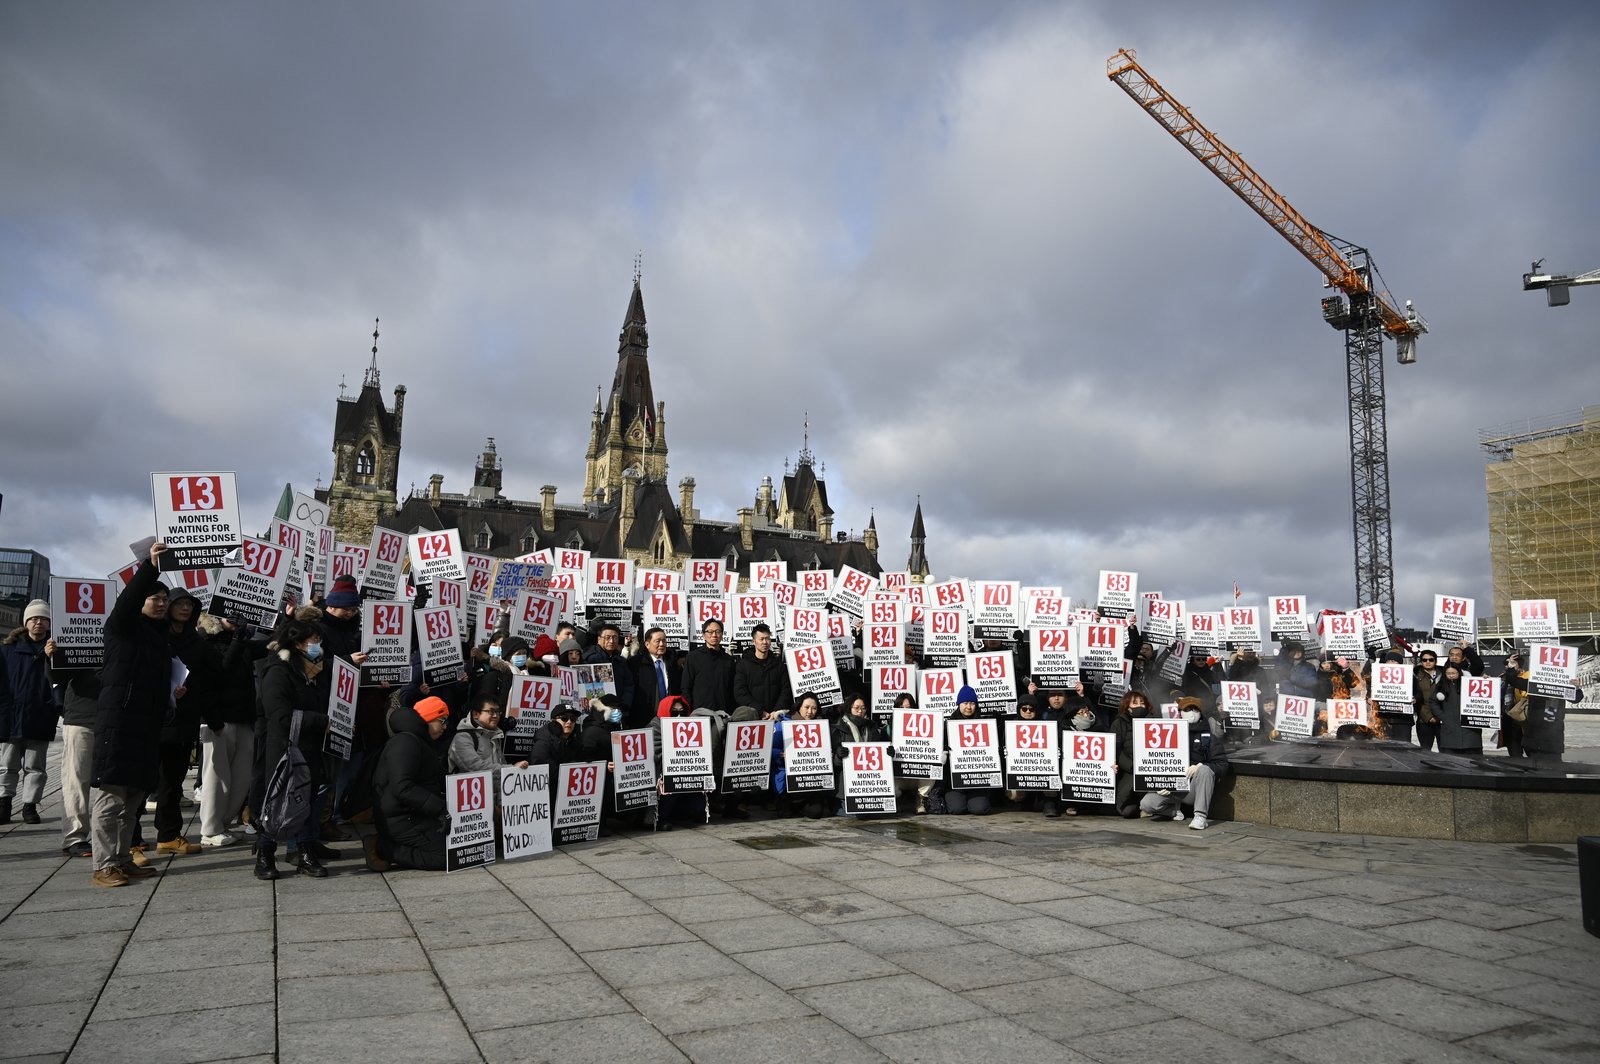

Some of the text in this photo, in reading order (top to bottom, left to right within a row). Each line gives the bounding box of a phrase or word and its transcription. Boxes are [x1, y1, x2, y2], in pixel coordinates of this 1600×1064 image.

[177, 476, 215, 510] 13
[168, 525, 229, 534] WAITING FOR
[178, 516, 217, 524] MONTHS
[163, 534, 235, 545] IRCC RESPONSE
[281, 526, 299, 551] 30
[378, 534, 401, 562] 36
[422, 535, 449, 558] 42
[178, 558, 189, 566] NO
[186, 549, 225, 557] TIMELINES
[243, 543, 277, 576] 30
[564, 552, 581, 569] 31
[237, 573, 269, 586] MONTHS
[501, 563, 545, 576] STOP THE
[600, 563, 621, 584] 11
[695, 562, 716, 581] 53
[227, 579, 275, 597] WAITING FOR
[472, 570, 489, 592] 32
[647, 574, 667, 591] 15
[806, 573, 826, 591] 33
[846, 572, 869, 595] 33
[1109, 575, 1128, 591] 38
[78, 583, 93, 614] 8
[219, 586, 276, 607] IRCC RESPONSE
[774, 583, 794, 604] 68
[938, 583, 962, 605] 33
[986, 585, 1010, 605] 70
[526, 598, 550, 624] 54
[655, 594, 676, 615] 71
[702, 602, 723, 622] 53
[743, 597, 764, 618] 63
[874, 603, 895, 623] 55
[1037, 599, 1060, 615] 35
[1151, 601, 1170, 618] 32
[1278, 599, 1296, 614] 31
[1445, 599, 1464, 615] 37
[1525, 603, 1546, 619] 11
[71, 618, 101, 626] MONTHS
[377, 605, 401, 634] 34
[428, 611, 449, 639] 38
[796, 610, 818, 632] 68
[828, 618, 843, 637] 5
[935, 612, 957, 633] 90
[1194, 615, 1211, 631] 37
[1234, 609, 1252, 625] 37
[1334, 618, 1354, 633] 34
[62, 627, 96, 635] WAITING
[873, 627, 895, 648] 34
[1042, 630, 1066, 651] 22
[1092, 627, 1112, 648] 11
[378, 655, 407, 663] RESPONSE
[799, 647, 822, 671] 39
[1545, 647, 1566, 667] 14
[978, 657, 1003, 679] 65
[1382, 667, 1403, 684] 39
[339, 666, 354, 702] 37
[883, 668, 905, 690] 40
[928, 672, 952, 694] 72
[1470, 680, 1490, 698] 25
[524, 681, 549, 710] 42
[1231, 684, 1248, 700] 23
[1287, 698, 1306, 717] 20
[1338, 703, 1356, 719] 39
[676, 722, 700, 748] 62
[796, 724, 819, 748] 35
[905, 714, 931, 737] 40
[963, 724, 986, 747] 51
[1148, 724, 1174, 748] 37
[739, 725, 761, 750] 81
[1019, 725, 1044, 748] 34
[624, 734, 645, 761] 31
[1076, 736, 1103, 760] 36
[856, 747, 880, 770] 43
[502, 773, 550, 796] CANADA
[570, 766, 594, 796] 36
[460, 778, 482, 811] 18
[503, 803, 548, 827] WHAT ARE
